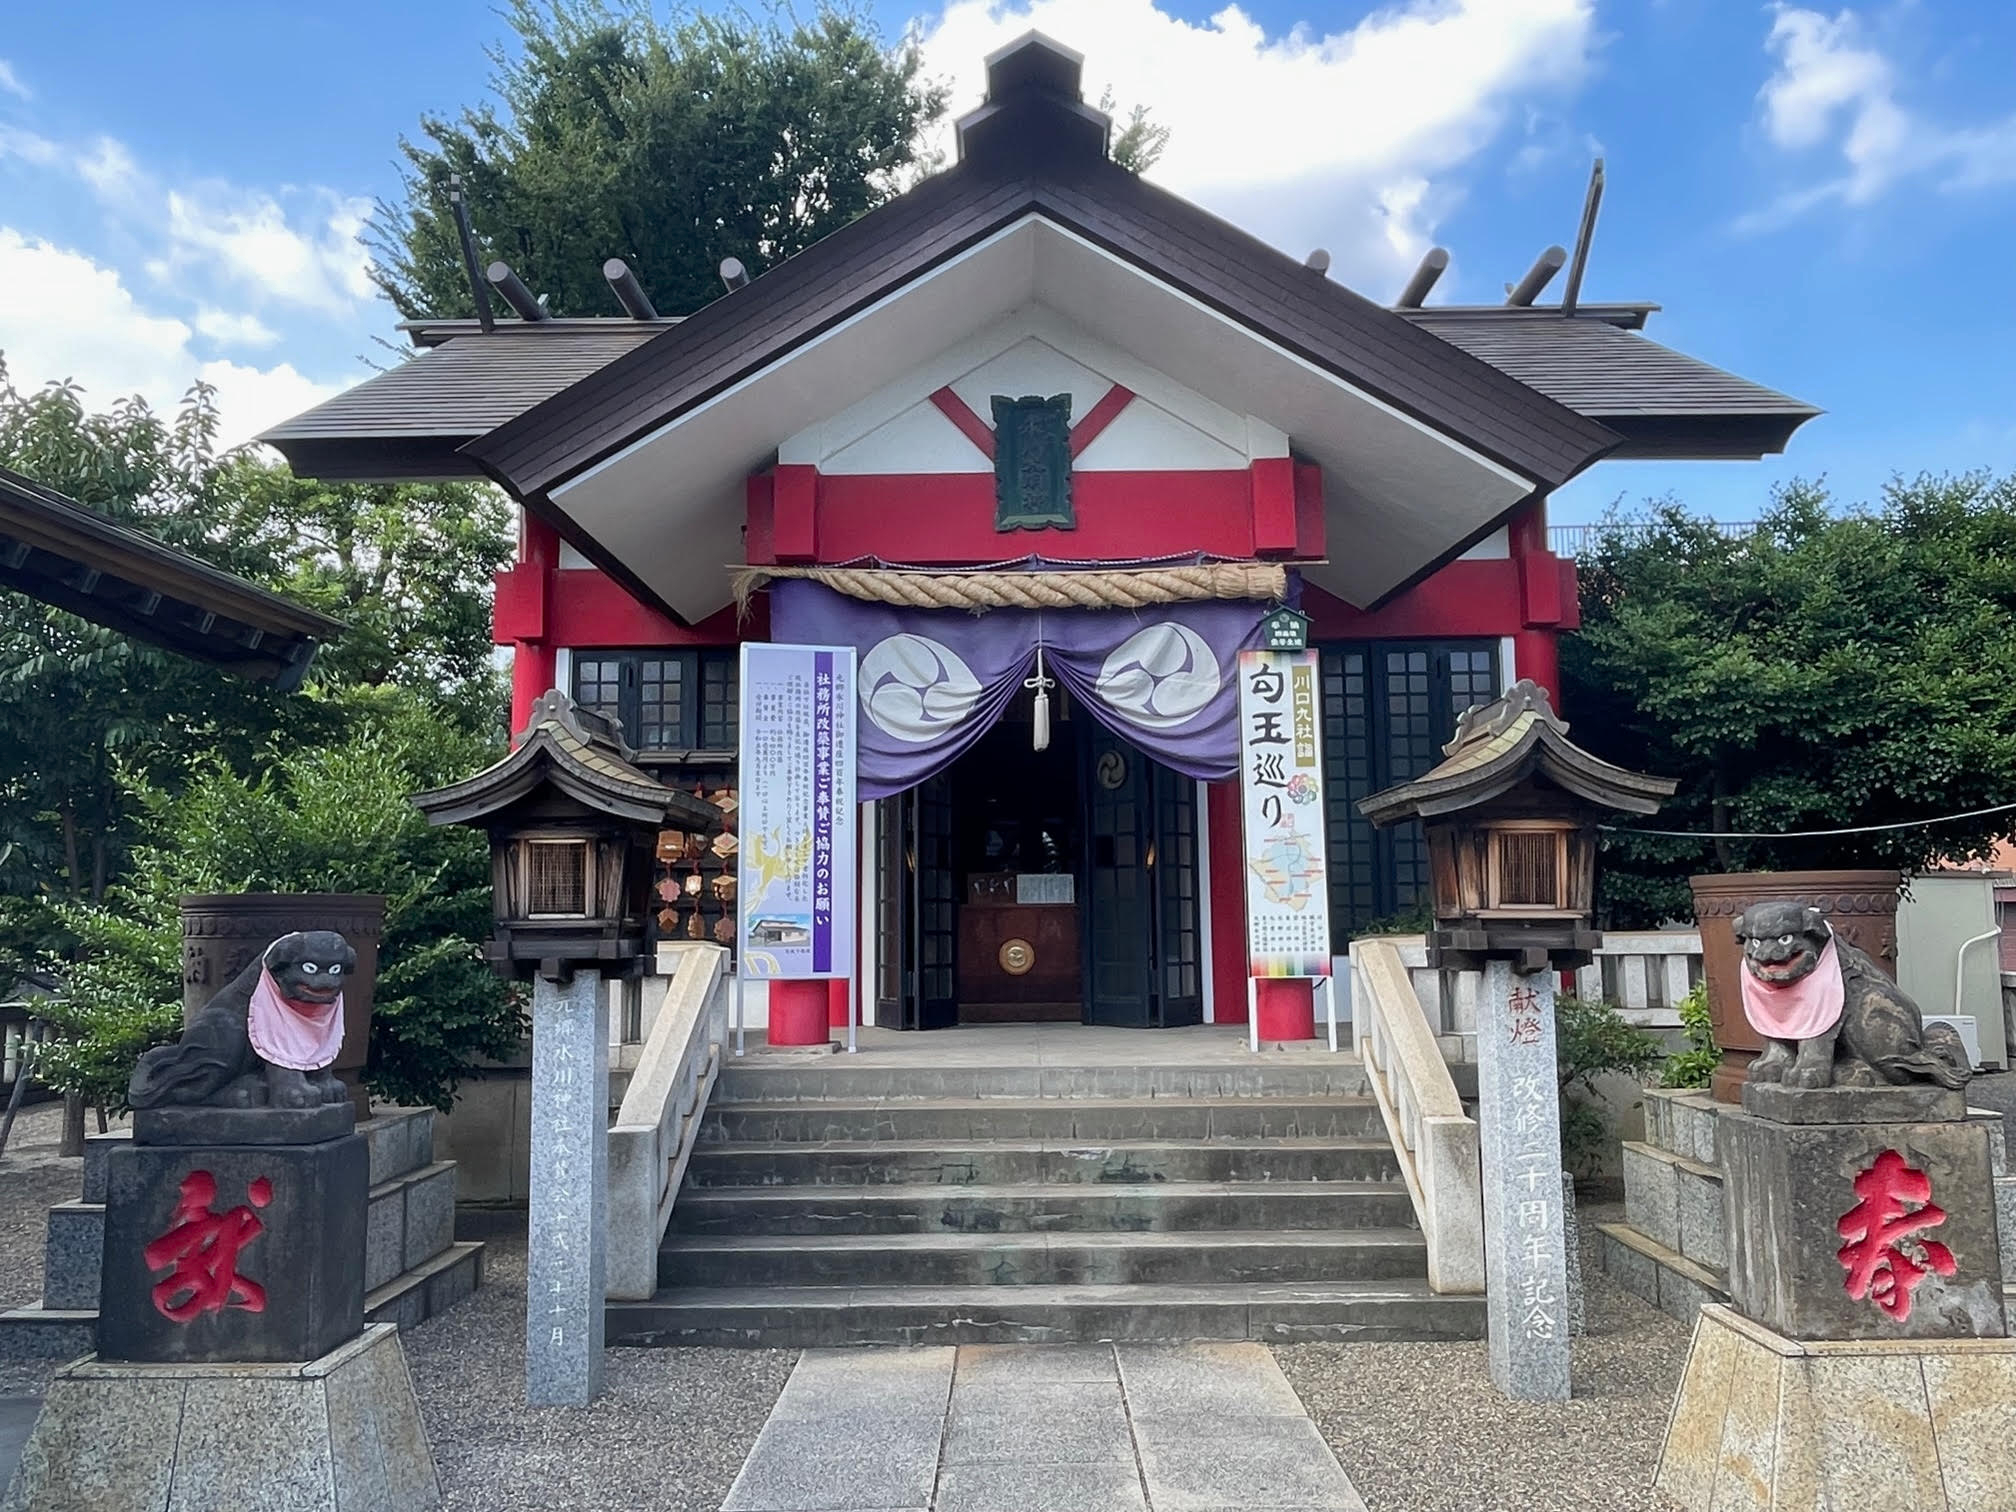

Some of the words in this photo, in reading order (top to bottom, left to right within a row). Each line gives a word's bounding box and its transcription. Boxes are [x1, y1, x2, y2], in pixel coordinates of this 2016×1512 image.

[1249, 663, 1292, 828] 勾玉巡り
[1508, 986, 1543, 1045] 献燈
[1512, 1071, 1556, 1340] 改修二十周年記念
